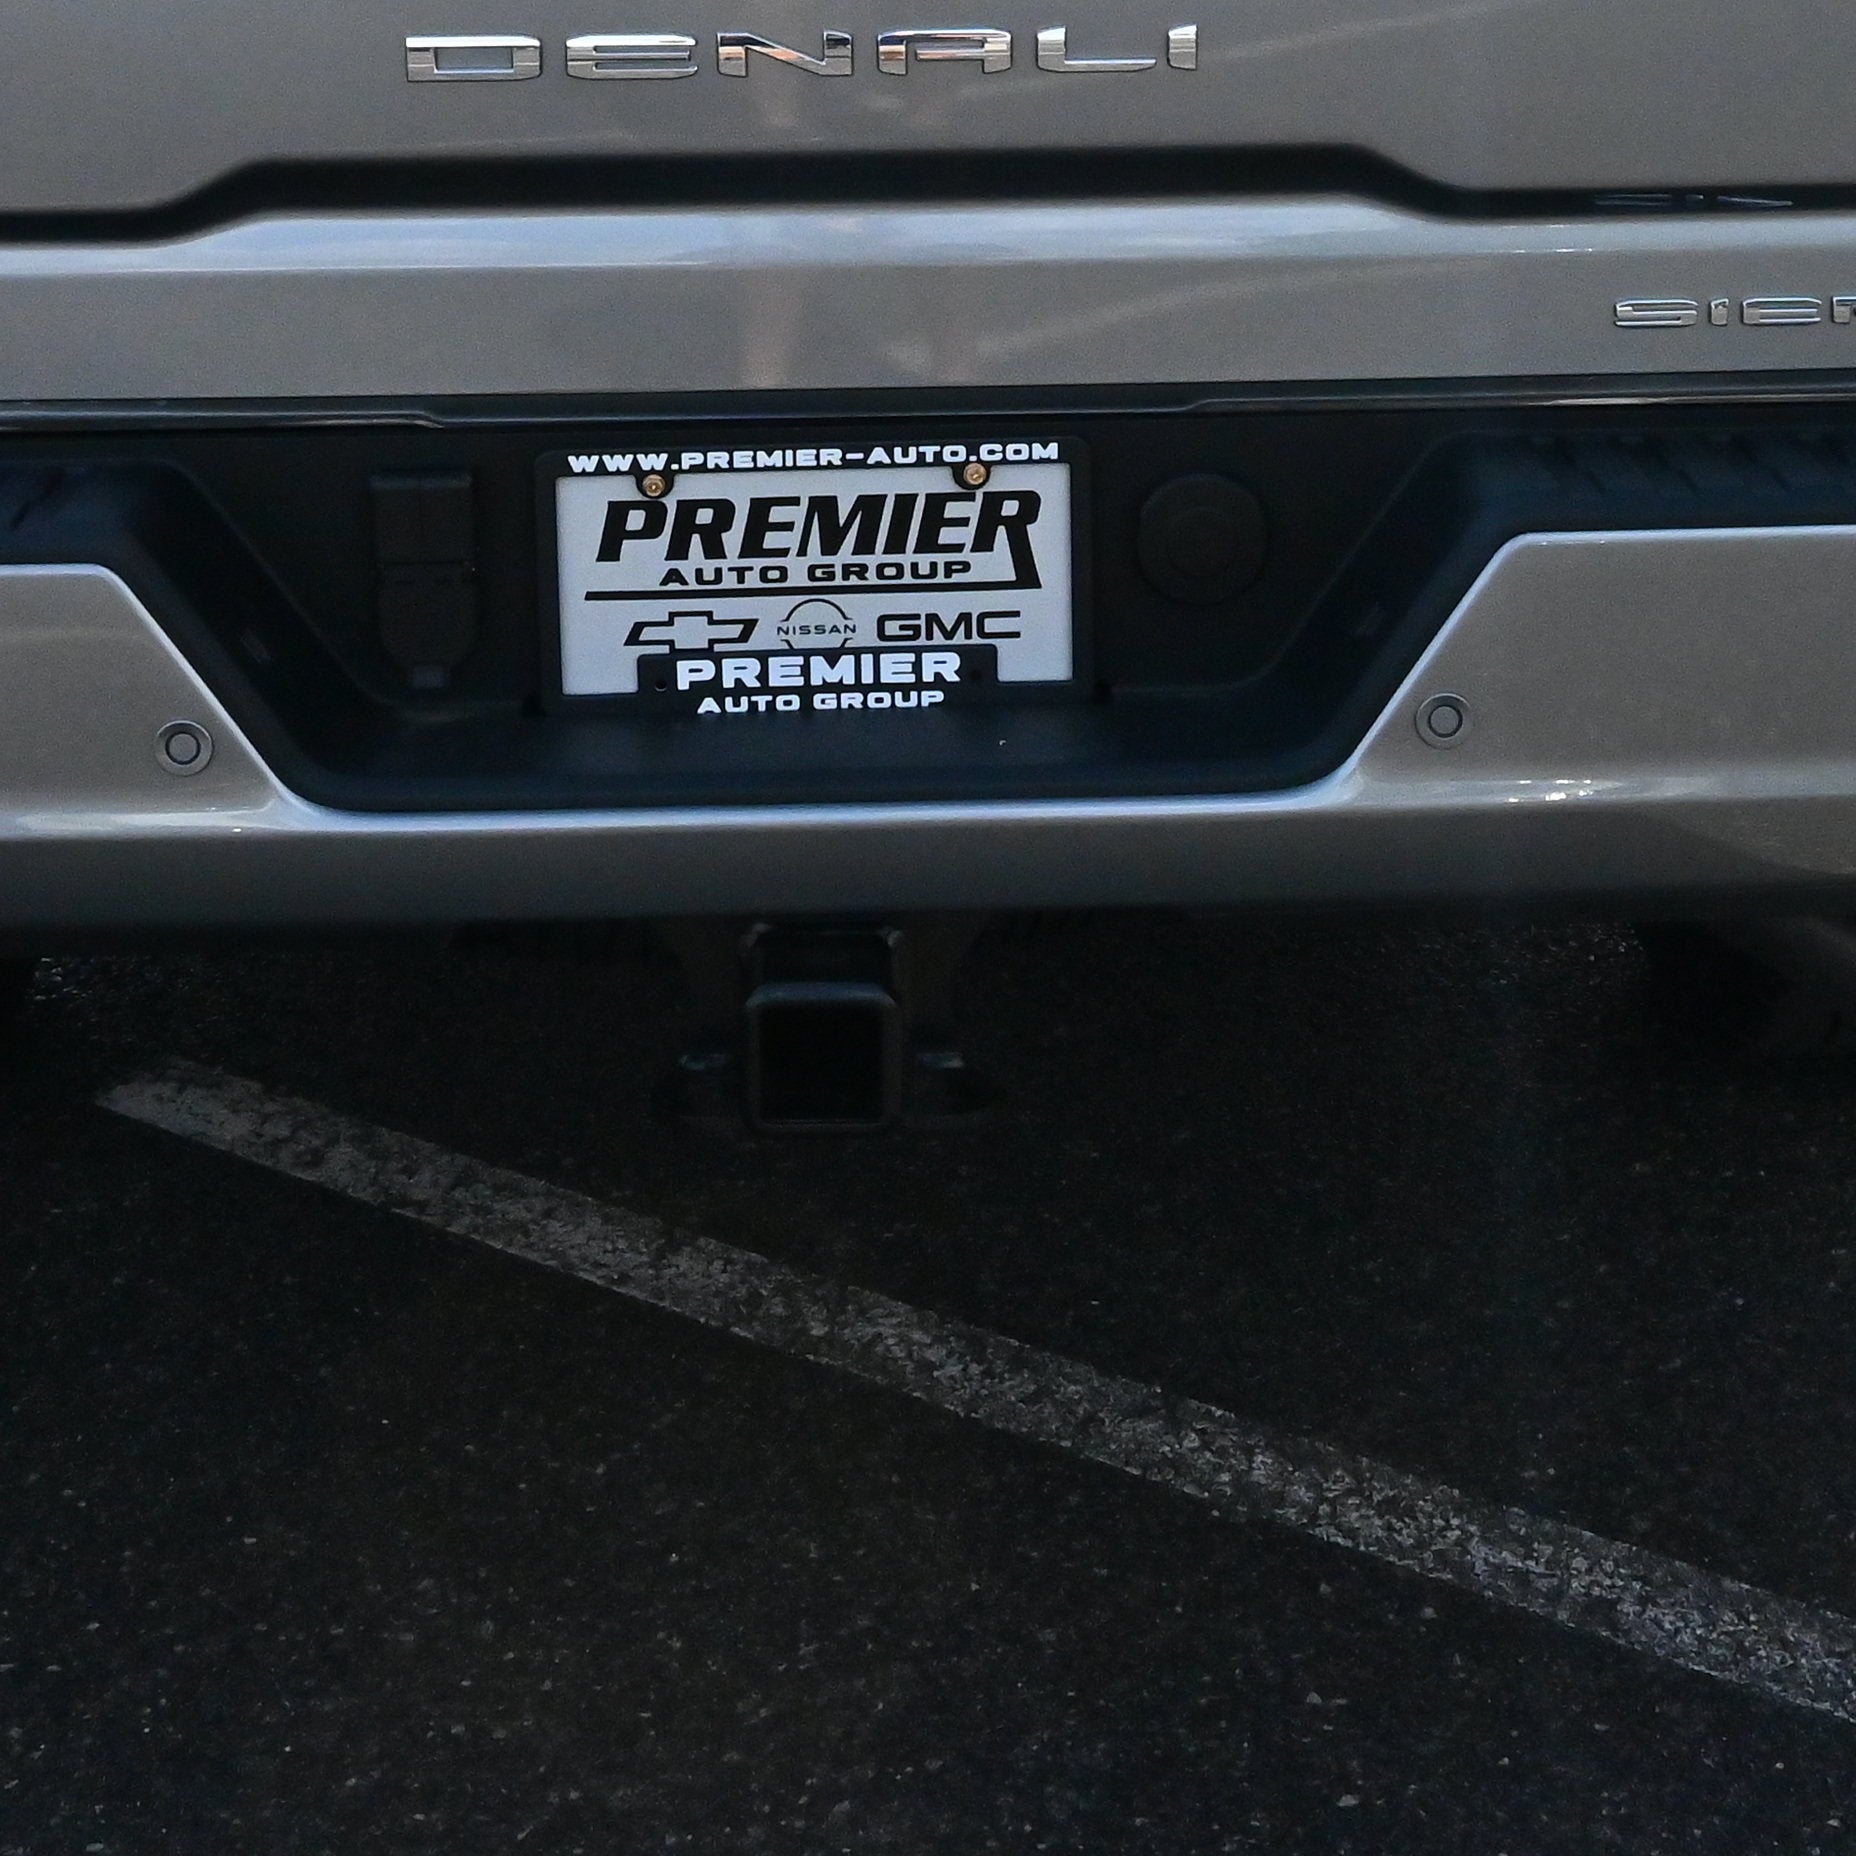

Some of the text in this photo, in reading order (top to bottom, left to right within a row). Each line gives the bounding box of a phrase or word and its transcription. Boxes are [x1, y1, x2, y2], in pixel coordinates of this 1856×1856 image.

[405, 24, 1198, 82] DENALI
[568, 443, 1060, 472] WWW.PREMIER-AUTO.COM
[596, 490, 1043, 588] PREMIER
[659, 561, 973, 586] AUTO GROUP
[776, 610, 1022, 642] NISSAN GMC
[676, 651, 962, 690] PREMIER
[697, 691, 945, 715] AUTO GROUP
